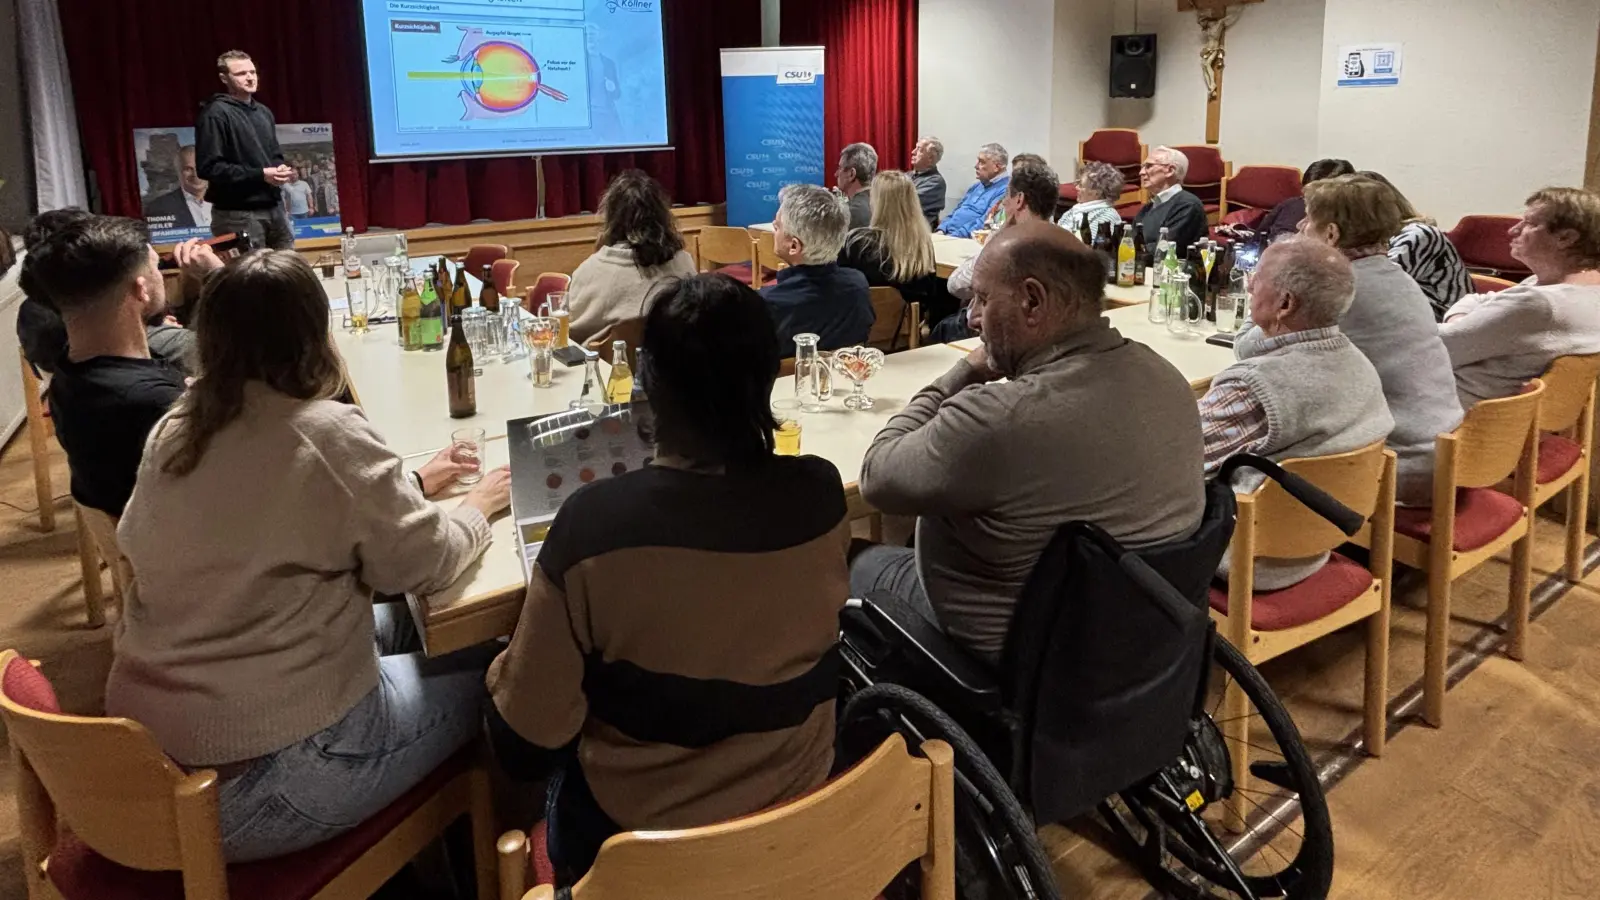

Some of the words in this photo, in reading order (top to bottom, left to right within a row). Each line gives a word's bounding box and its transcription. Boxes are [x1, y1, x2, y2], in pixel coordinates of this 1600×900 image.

[400, 3, 440, 11] Kurzsichtigkeit
[621, 0, 652, 8] Köllner
[146, 214, 176, 222] THOMAS
